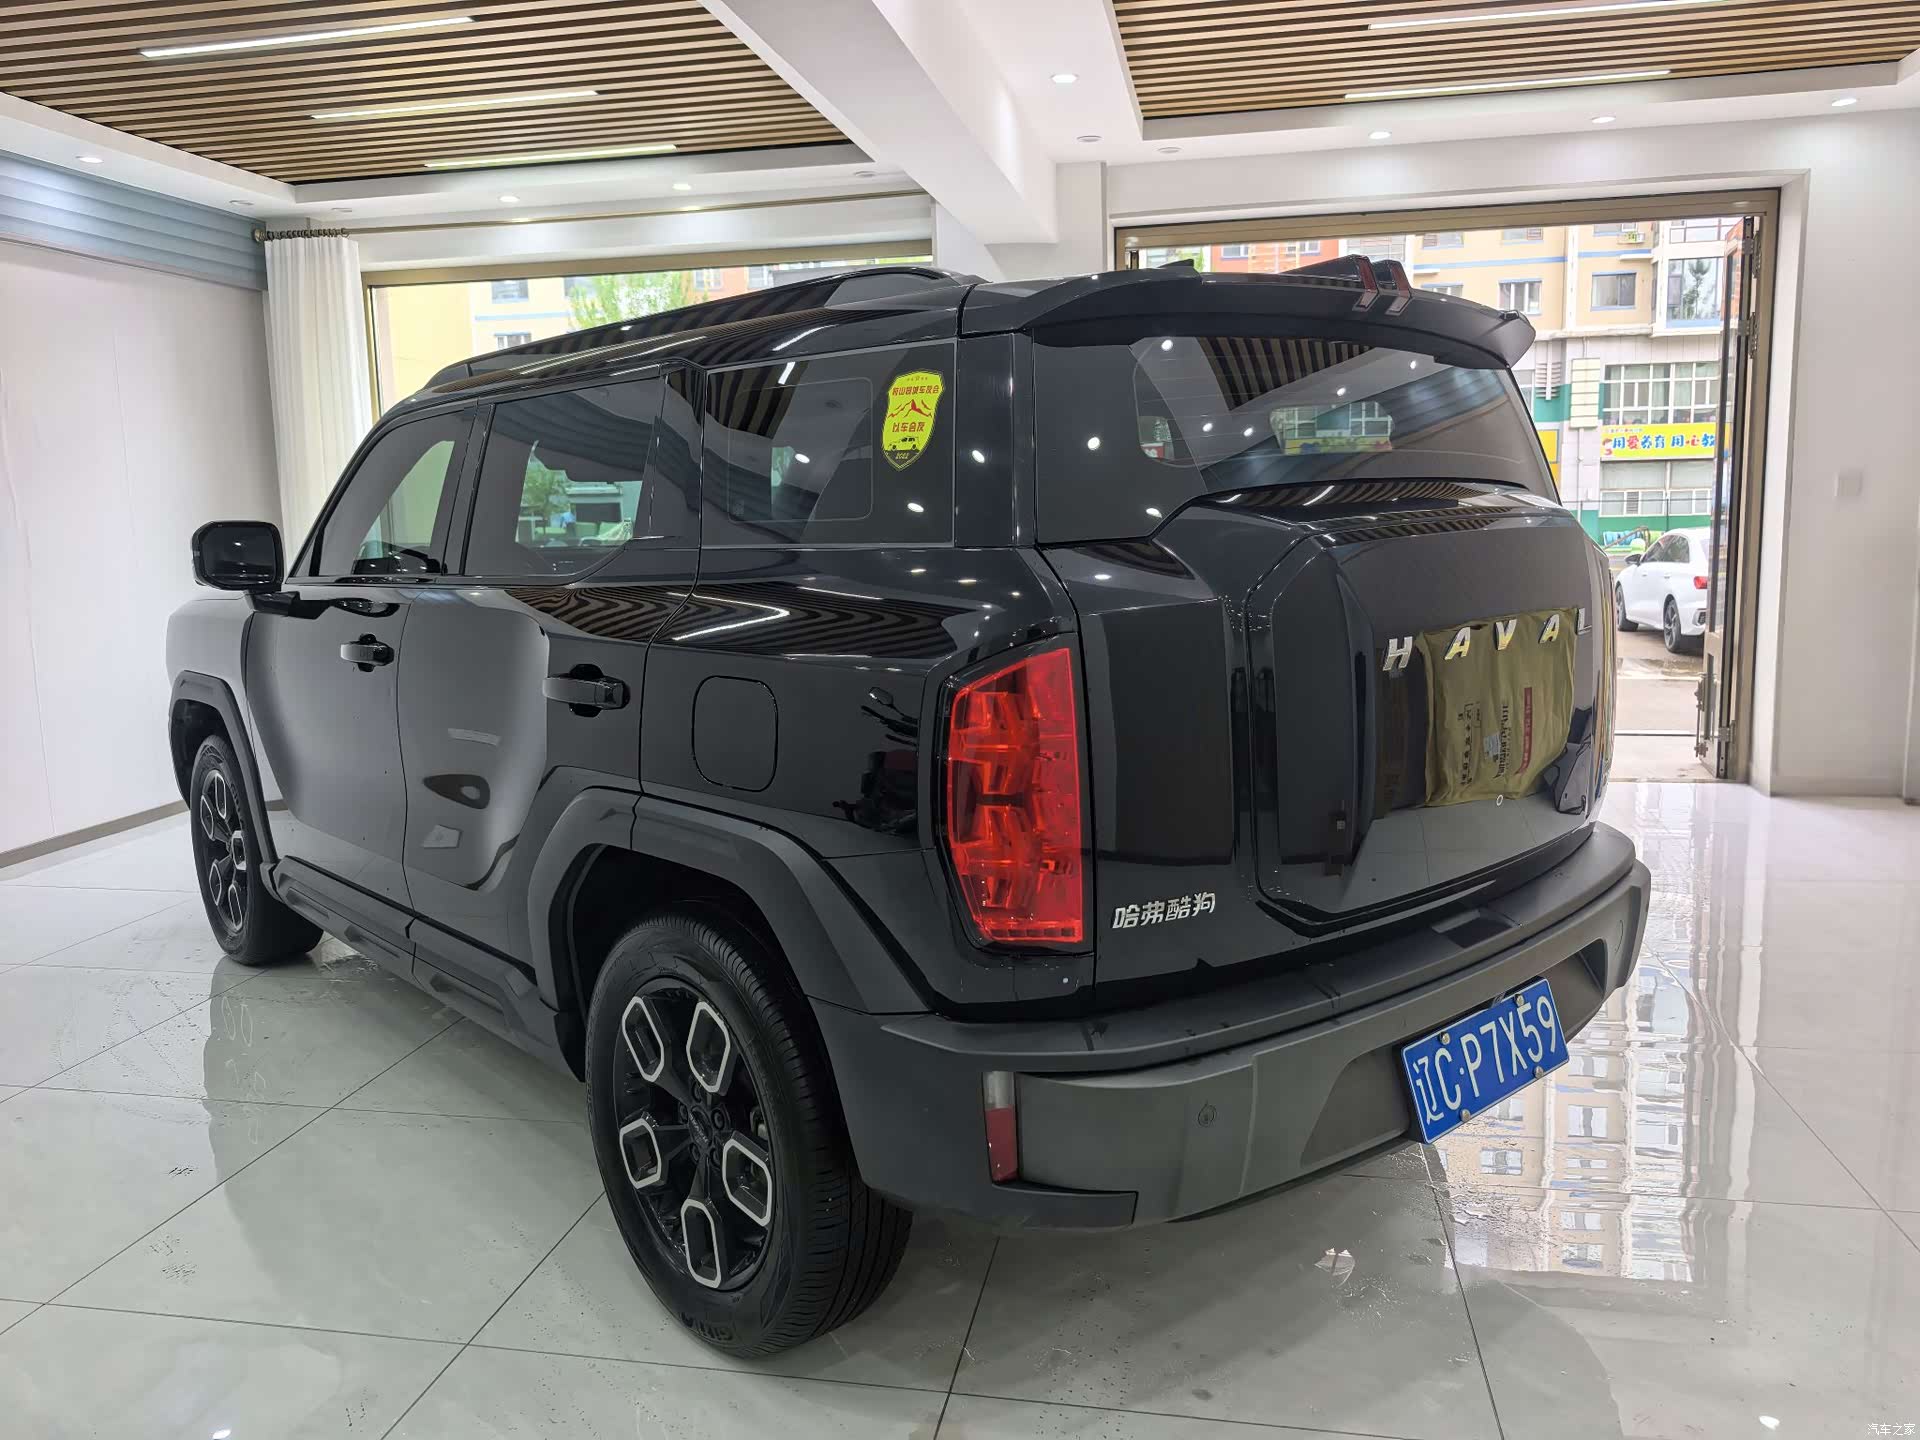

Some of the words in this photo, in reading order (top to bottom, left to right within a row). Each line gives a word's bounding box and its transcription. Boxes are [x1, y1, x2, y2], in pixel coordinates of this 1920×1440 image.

[1612, 434, 1665, 450] 用爱养育
[1383, 608, 1592, 671] HAVAL
[1112, 891, 1216, 929] 哈弗酷狗
